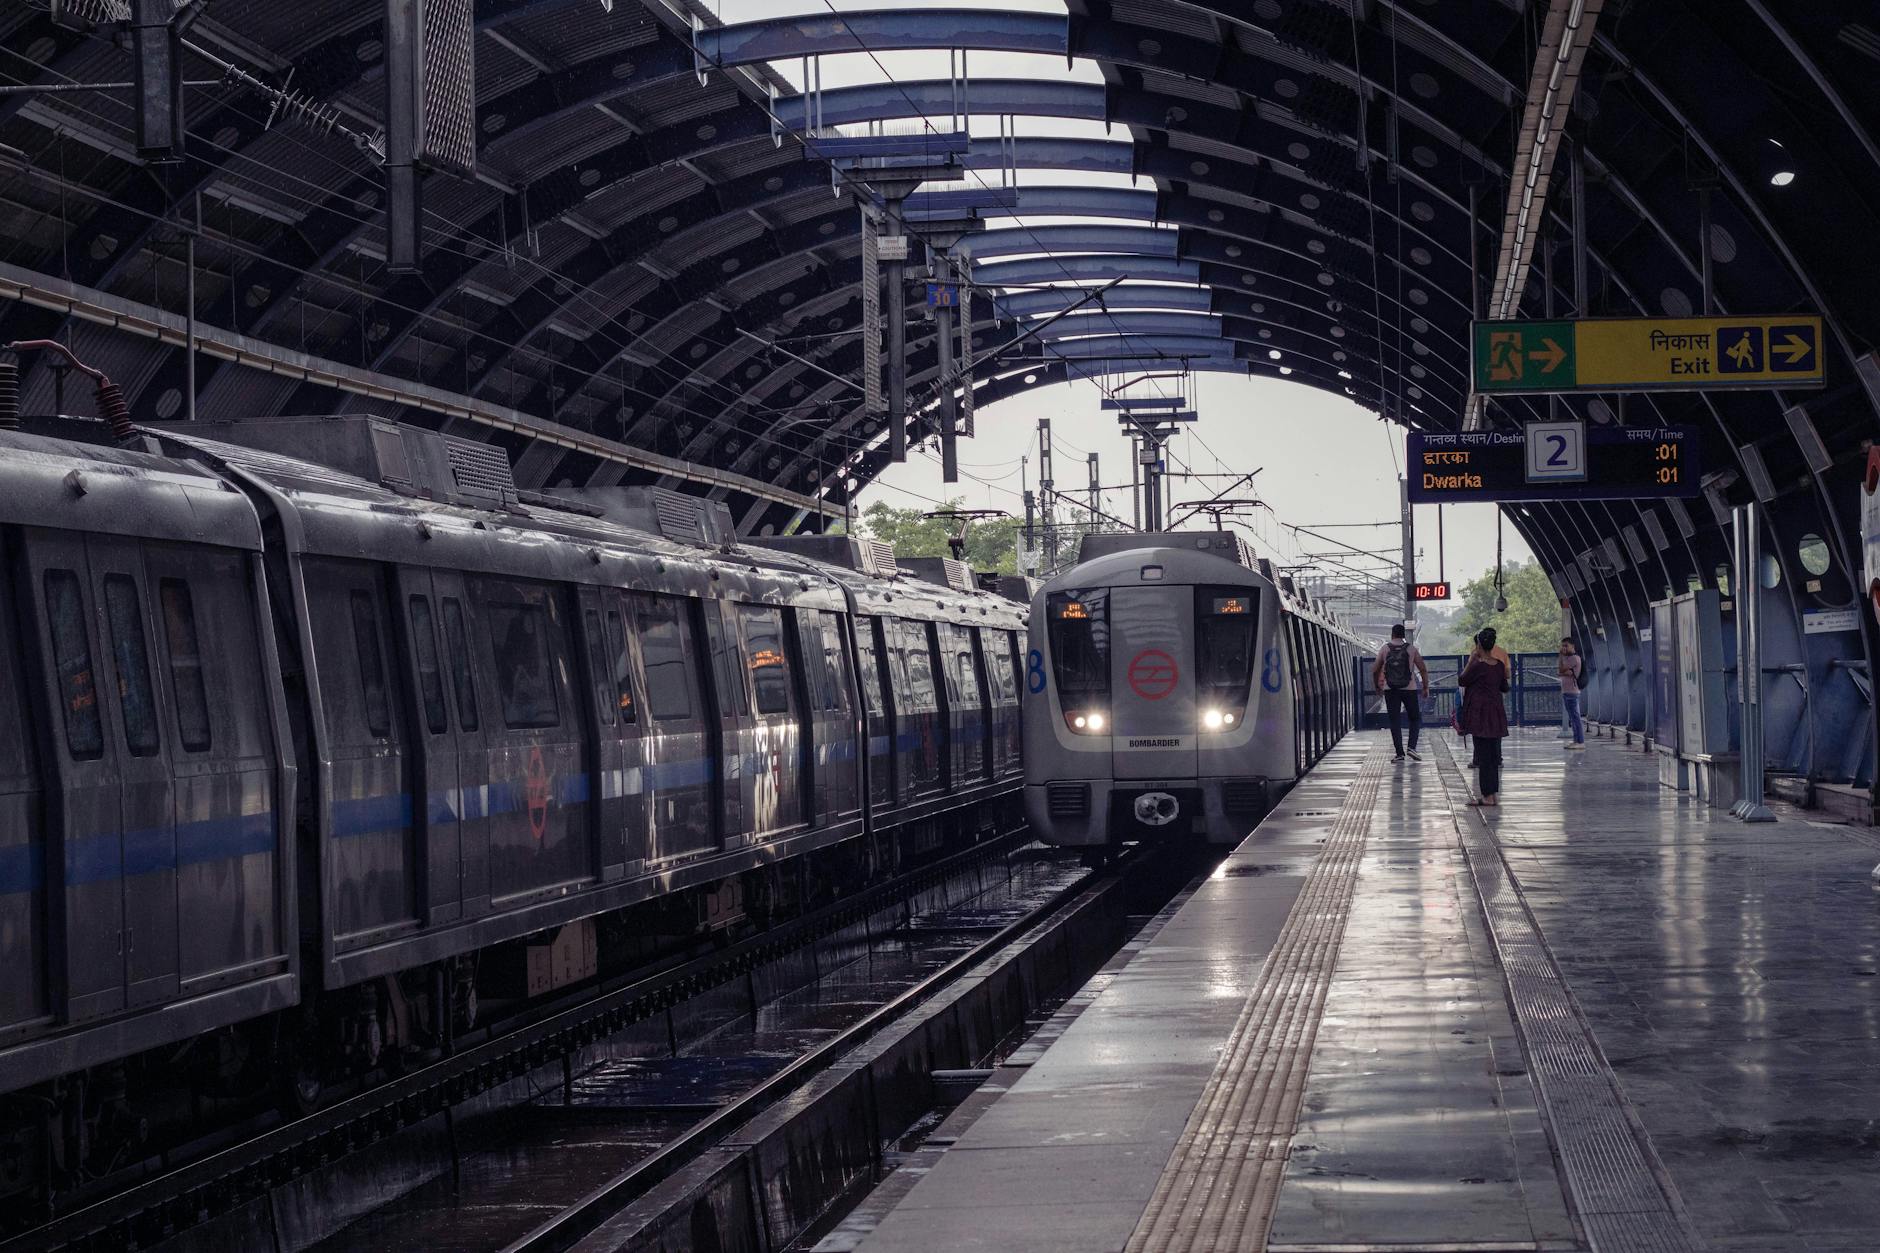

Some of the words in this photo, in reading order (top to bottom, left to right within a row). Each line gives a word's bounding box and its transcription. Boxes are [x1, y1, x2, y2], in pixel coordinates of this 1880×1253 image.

[1649, 329, 1711, 352] निकास
[1671, 357, 1710, 374] Exit
[1423, 434, 1457, 445] गन्तव्य
[1626, 428, 1684, 440] समय/Time
[1546, 434, 1568, 466] 2
[1656, 444, 1677, 460] :01
[1423, 452, 1471, 465] द्वारका
[1423, 473, 1482, 488] Dwarka
[1657, 467, 1678, 483] :01
[1416, 585, 1446, 598] 10:10
[1029, 649, 1046, 694] 8
[1262, 648, 1282, 693] 8
[1129, 739, 1180, 748] BOMBARDIER
